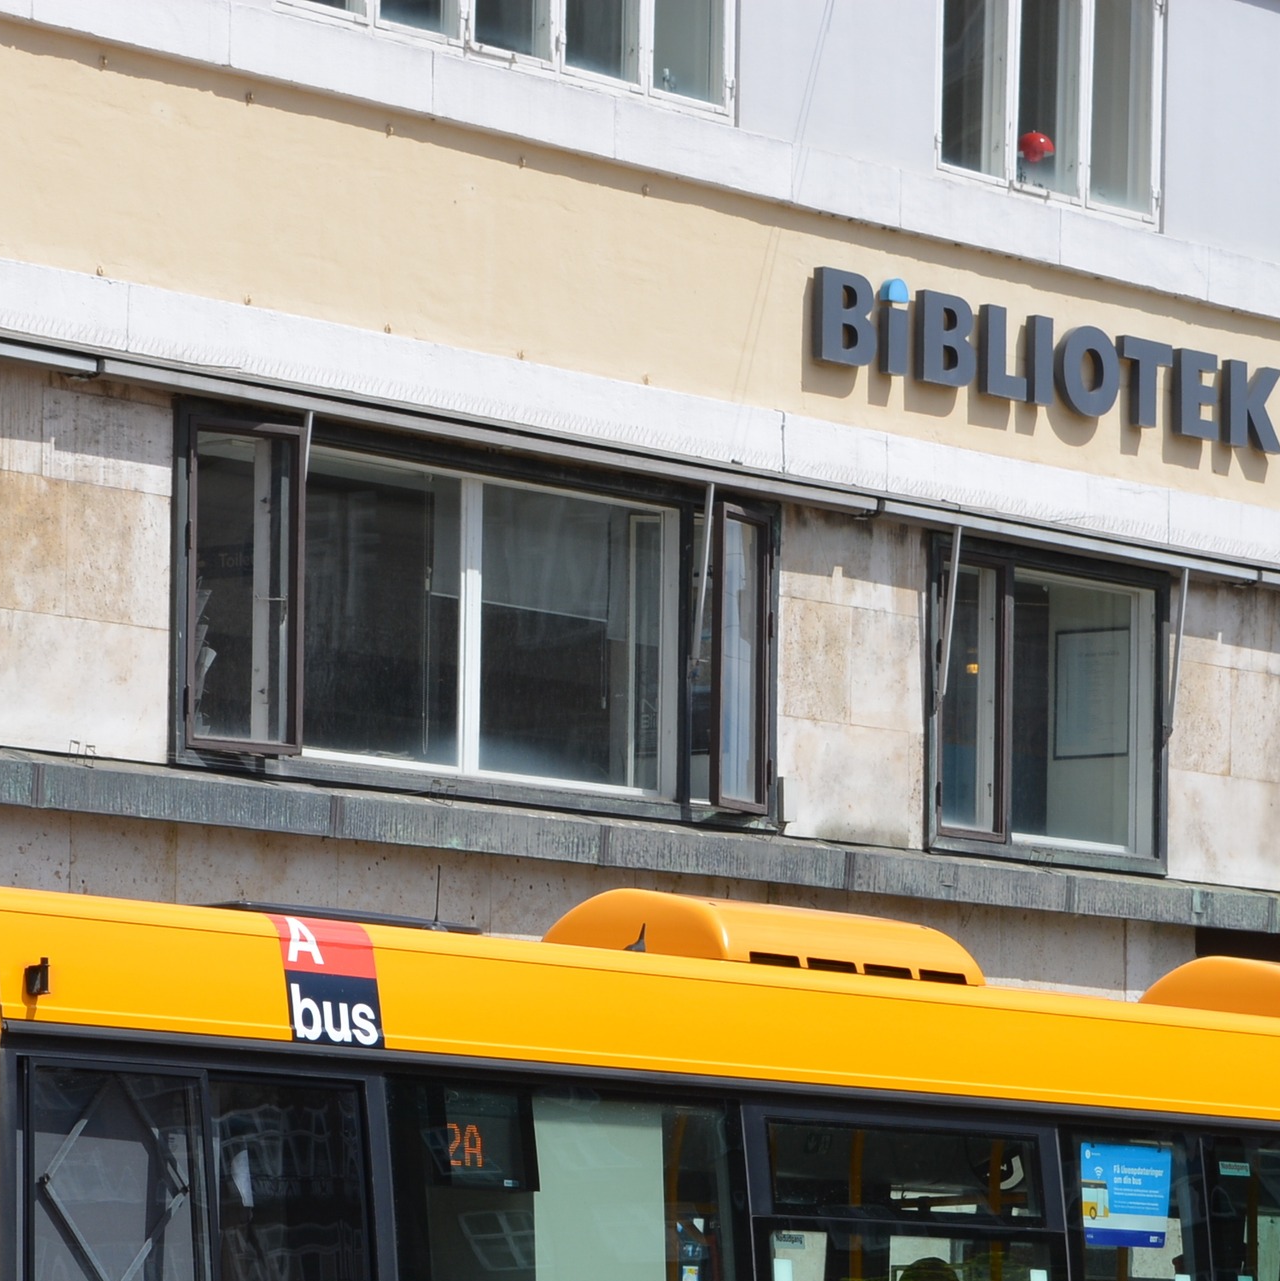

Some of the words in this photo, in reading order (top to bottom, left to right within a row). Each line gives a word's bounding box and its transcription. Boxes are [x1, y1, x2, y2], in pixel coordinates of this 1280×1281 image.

[284, 916, 325, 965] A
[290, 982, 379, 1046] bus
[447, 1122, 483, 1167] 2A
